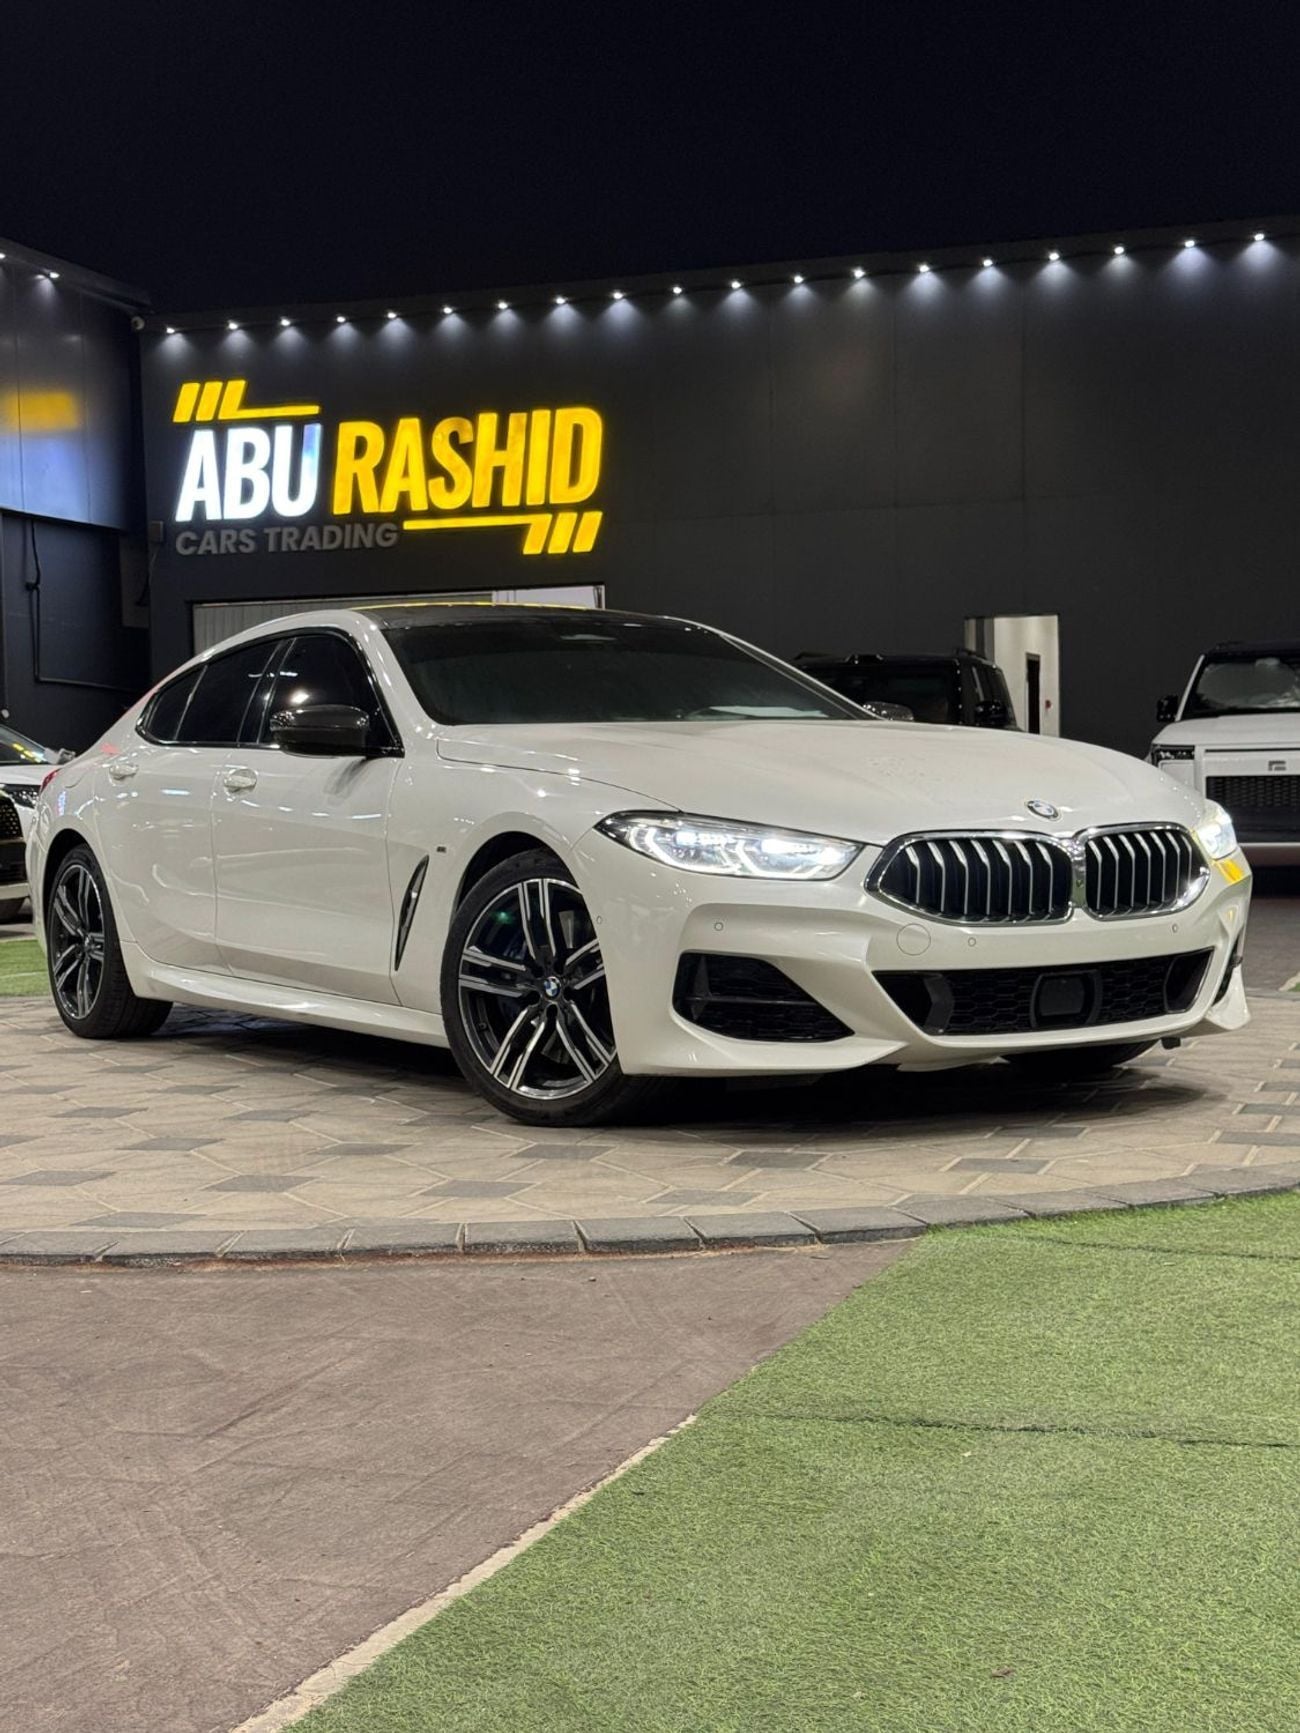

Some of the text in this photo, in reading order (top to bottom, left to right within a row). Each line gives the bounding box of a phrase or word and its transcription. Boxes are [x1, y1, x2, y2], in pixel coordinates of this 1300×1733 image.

[175, 407, 603, 522] ABU RASHID
[175, 523, 399, 556] CARS TRADING
